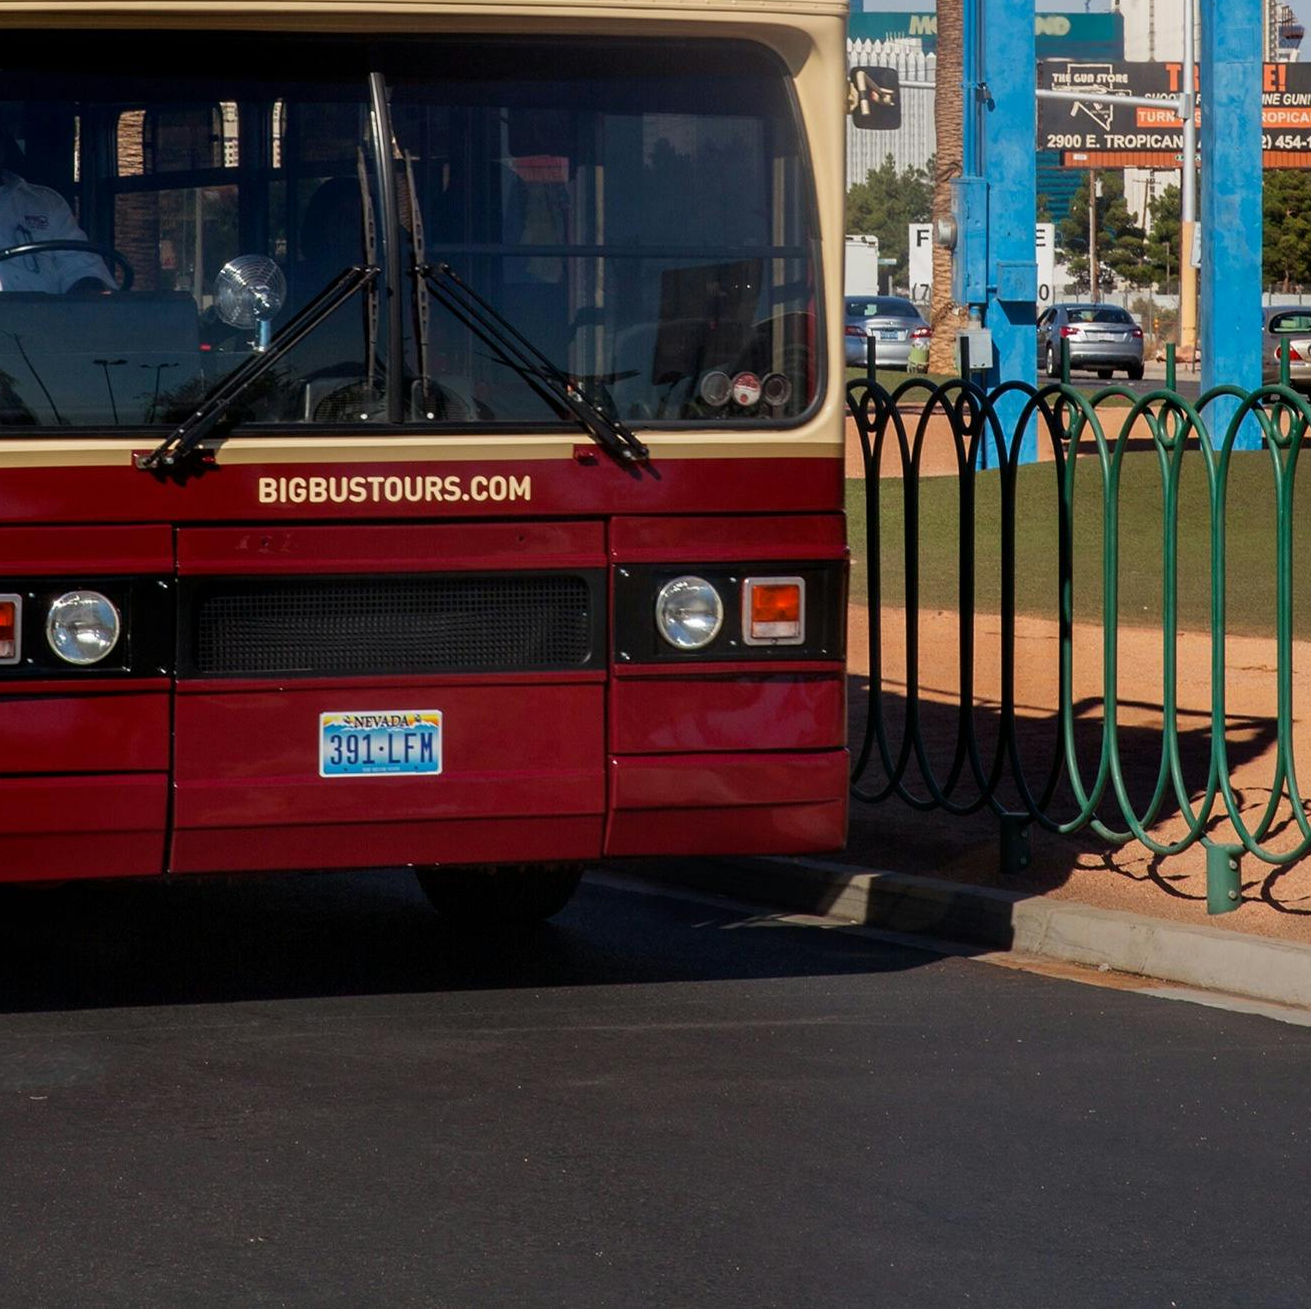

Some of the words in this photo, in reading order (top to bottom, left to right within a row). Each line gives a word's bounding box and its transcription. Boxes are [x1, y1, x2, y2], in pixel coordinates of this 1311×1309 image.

[1052, 73, 1072, 84] THE
[1096, 73, 1129, 84] STORE
[1283, 93, 1311, 106] GUN!
[1138, 111, 1176, 122] TURN
[1047, 134, 1082, 148] 2900
[1085, 134, 1101, 148] E.
[1103, 134, 1184, 149] TROPICAN
[258, 475, 532, 504] BIGBUSTOURS.COM
[354, 714, 410, 729] NEVADA
